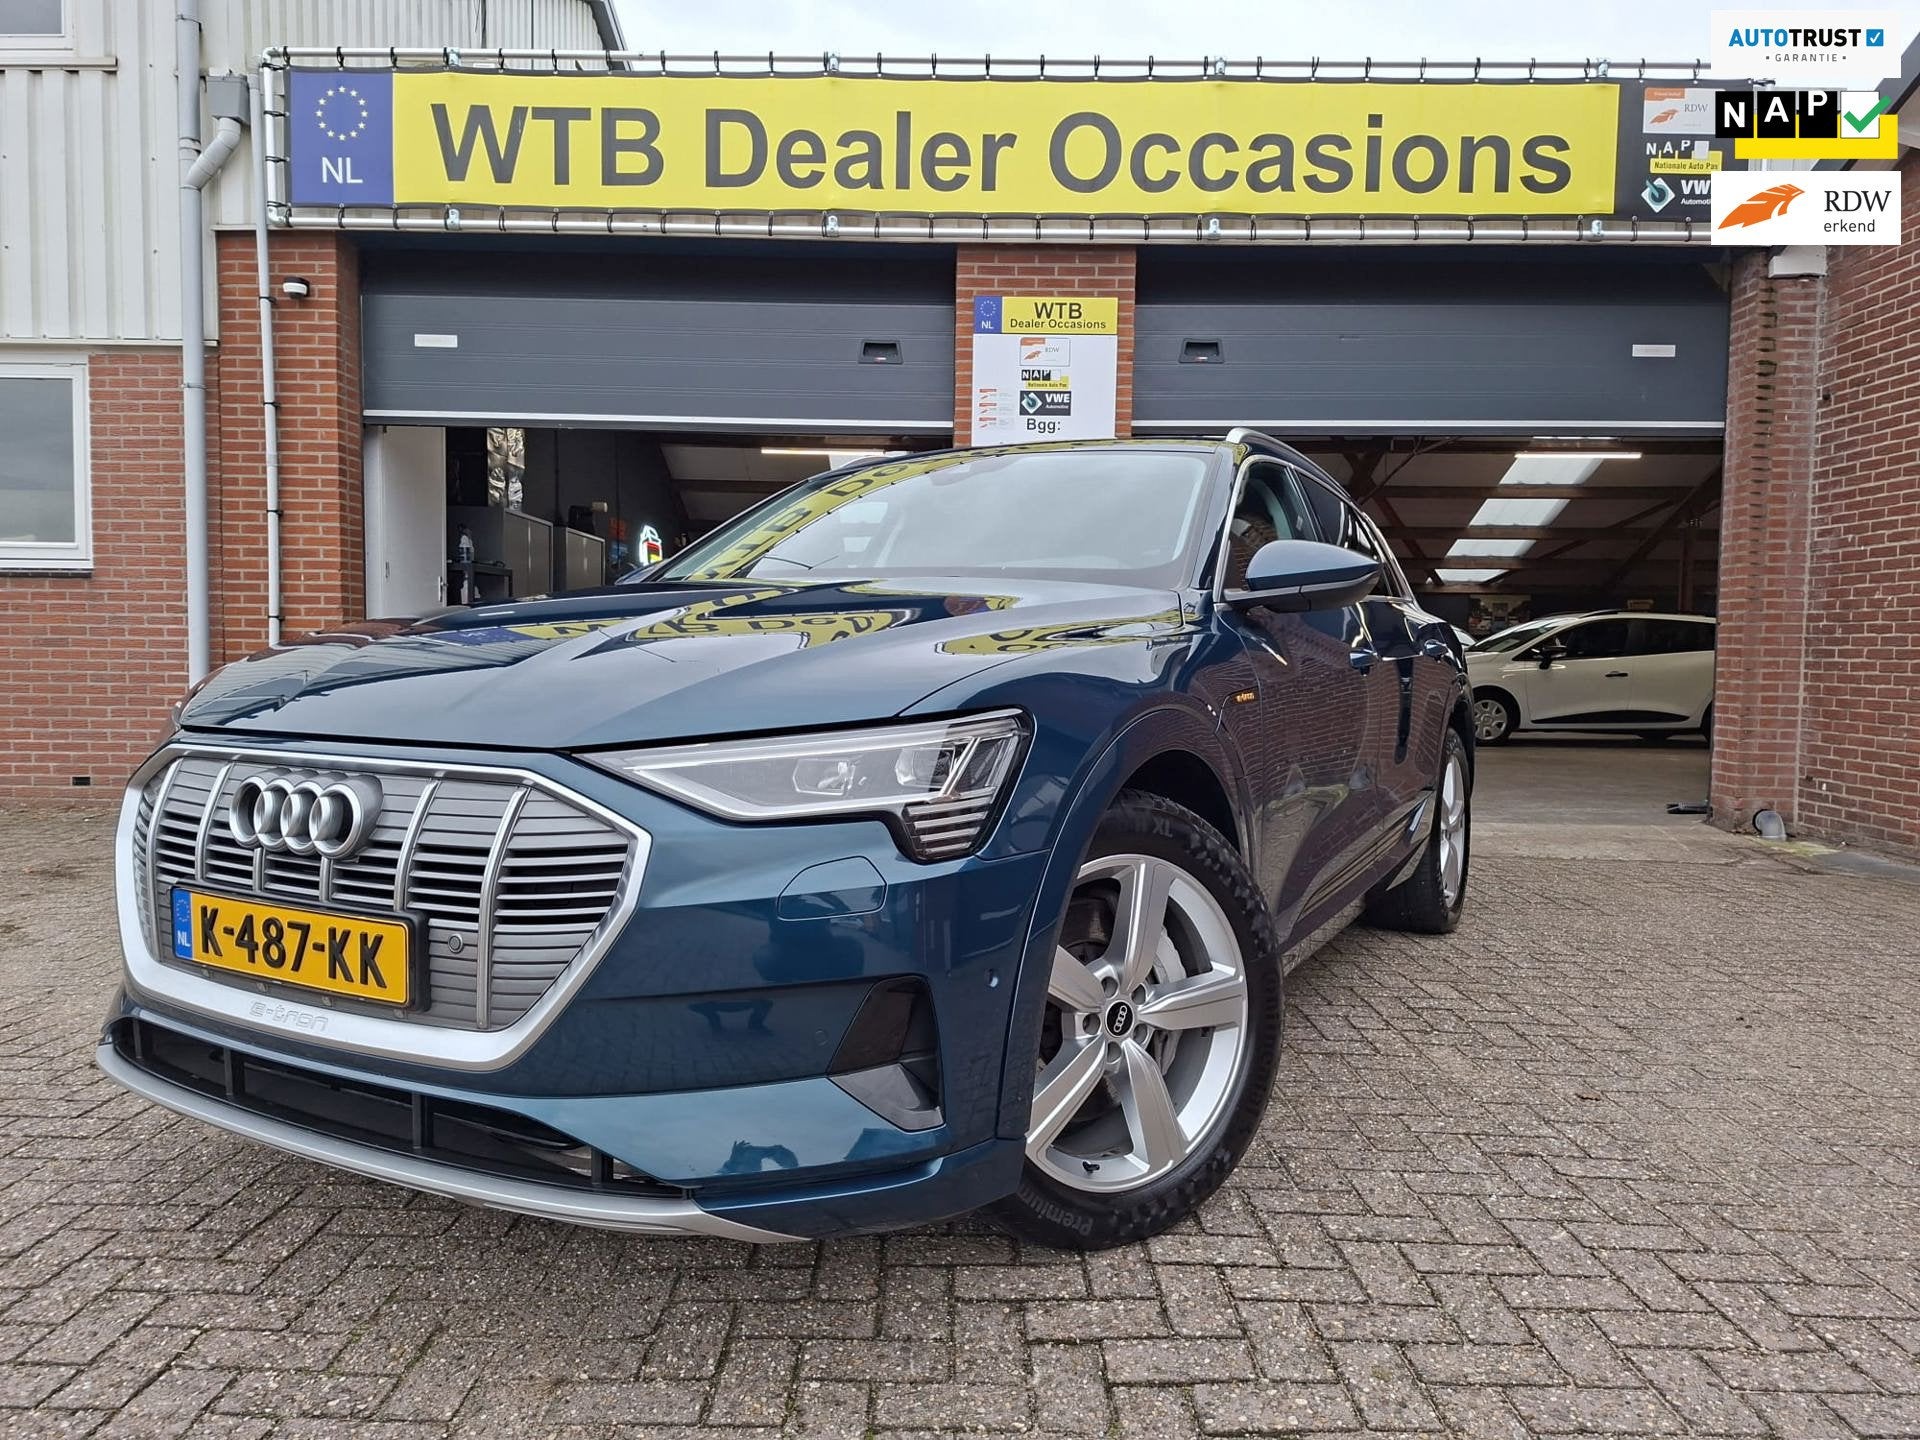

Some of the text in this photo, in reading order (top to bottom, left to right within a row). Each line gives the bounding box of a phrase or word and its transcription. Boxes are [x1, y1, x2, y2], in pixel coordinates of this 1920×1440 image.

[1684, 103, 1708, 113] RDW
[430, 102, 1572, 194] WTB Dealer Occasions
[321, 156, 363, 185] NL
[1654, 161, 1719, 170] Nationale Auto Pas
[1681, 180, 1711, 195] VW
[1034, 302, 1083, 319] WTB
[981, 321, 994, 329] NL
[1010, 318, 1106, 329] Dealer Occasions
[1045, 393, 1070, 403] VWE
[1026, 418, 1061, 433] Bgg:
[177, 930, 190, 948] NL
[200, 904, 387, 989] K-487-KK
[249, 1001, 329, 1031] e-tron
